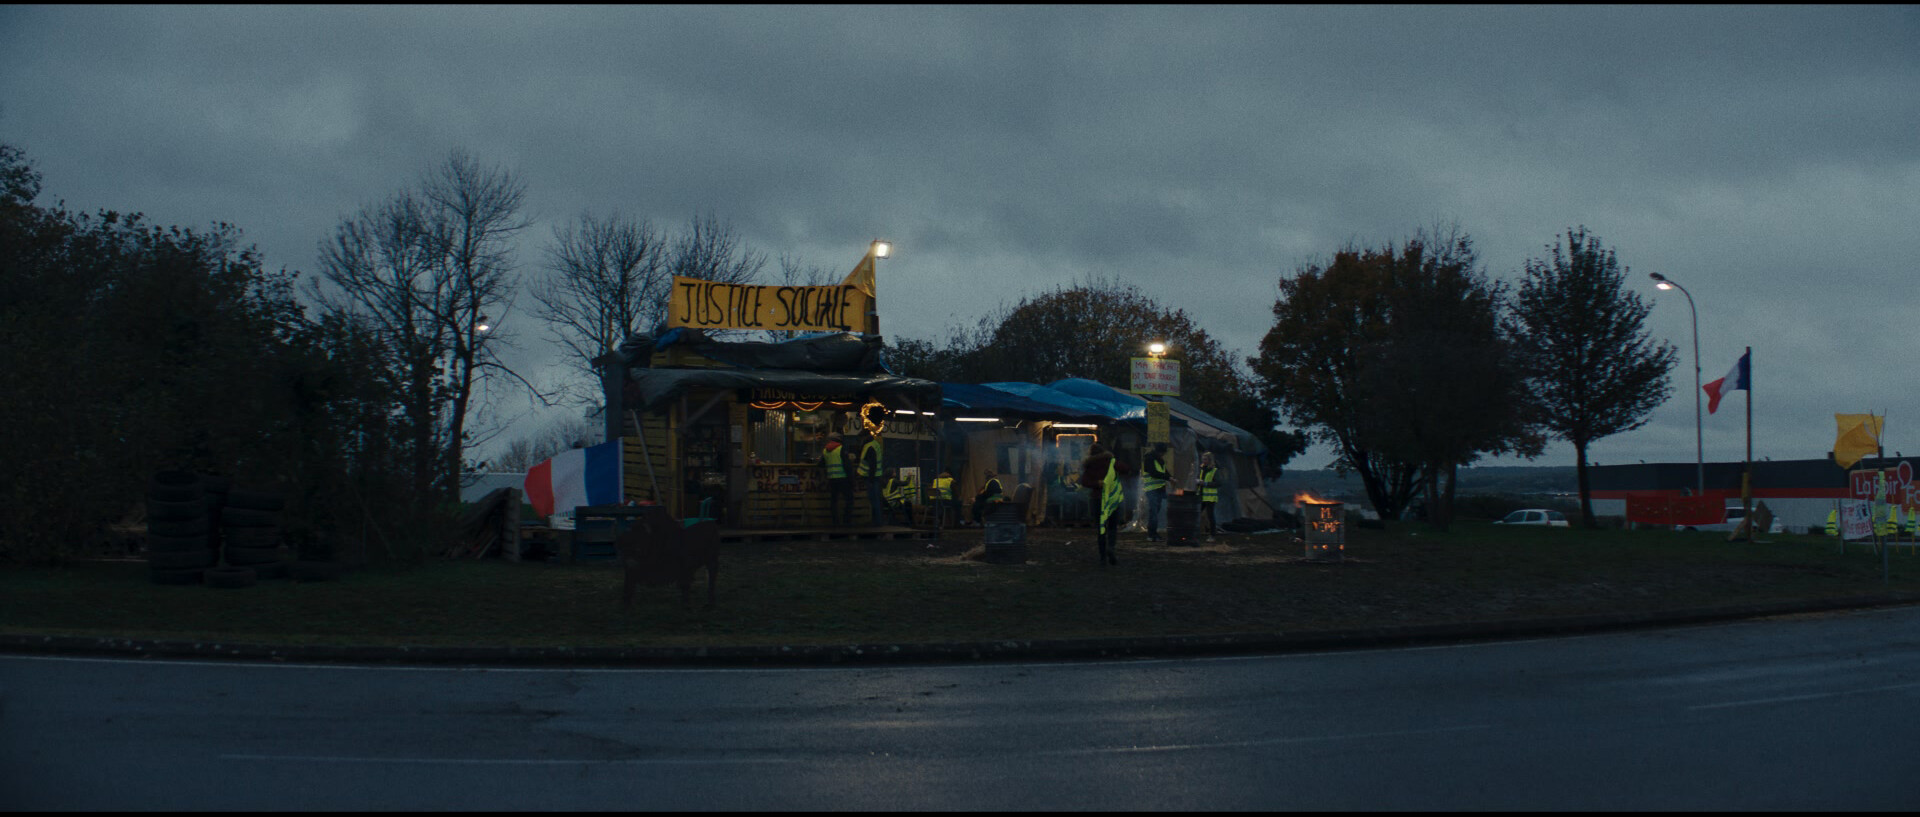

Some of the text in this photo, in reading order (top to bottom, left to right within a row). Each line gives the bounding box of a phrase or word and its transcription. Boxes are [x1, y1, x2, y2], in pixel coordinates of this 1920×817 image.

[680, 282, 856, 331] JUSTICE SOCIALE
[1855, 476, 1871, 495] La
